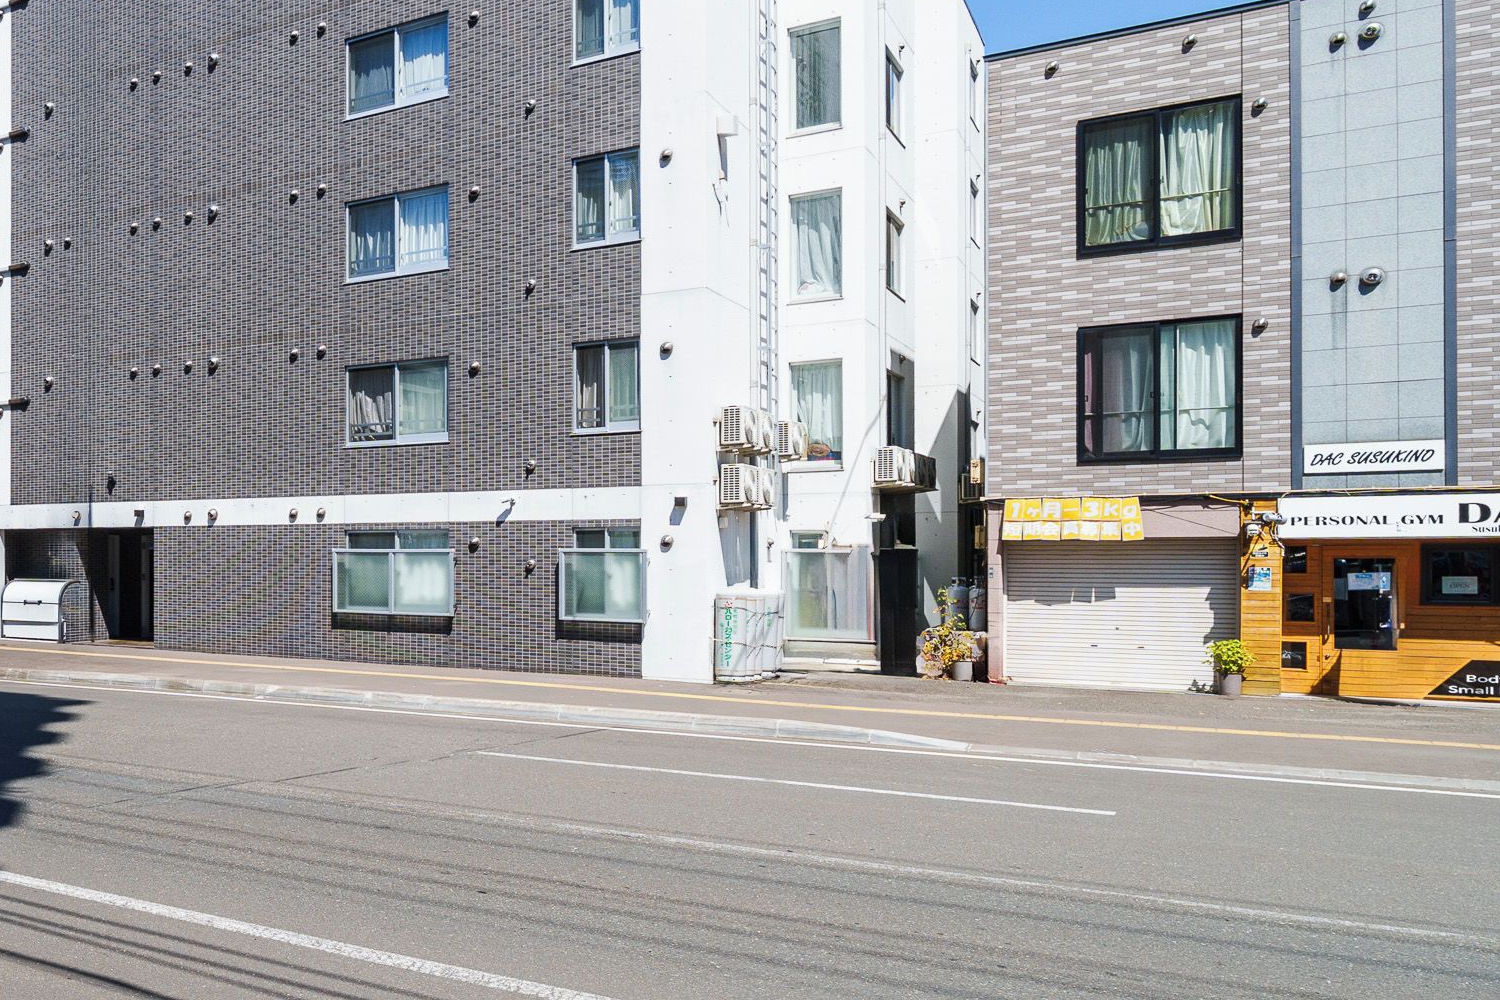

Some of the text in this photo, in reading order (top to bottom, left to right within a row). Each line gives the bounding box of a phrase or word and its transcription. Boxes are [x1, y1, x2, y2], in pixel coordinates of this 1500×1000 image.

[1310, 448, 1436, 466] DAC SUSUKINO
[1290, 502, 1500, 526] PERSONAL GYM D
[1466, 674, 1500, 684] Bod
[1448, 685, 1495, 696] Small
